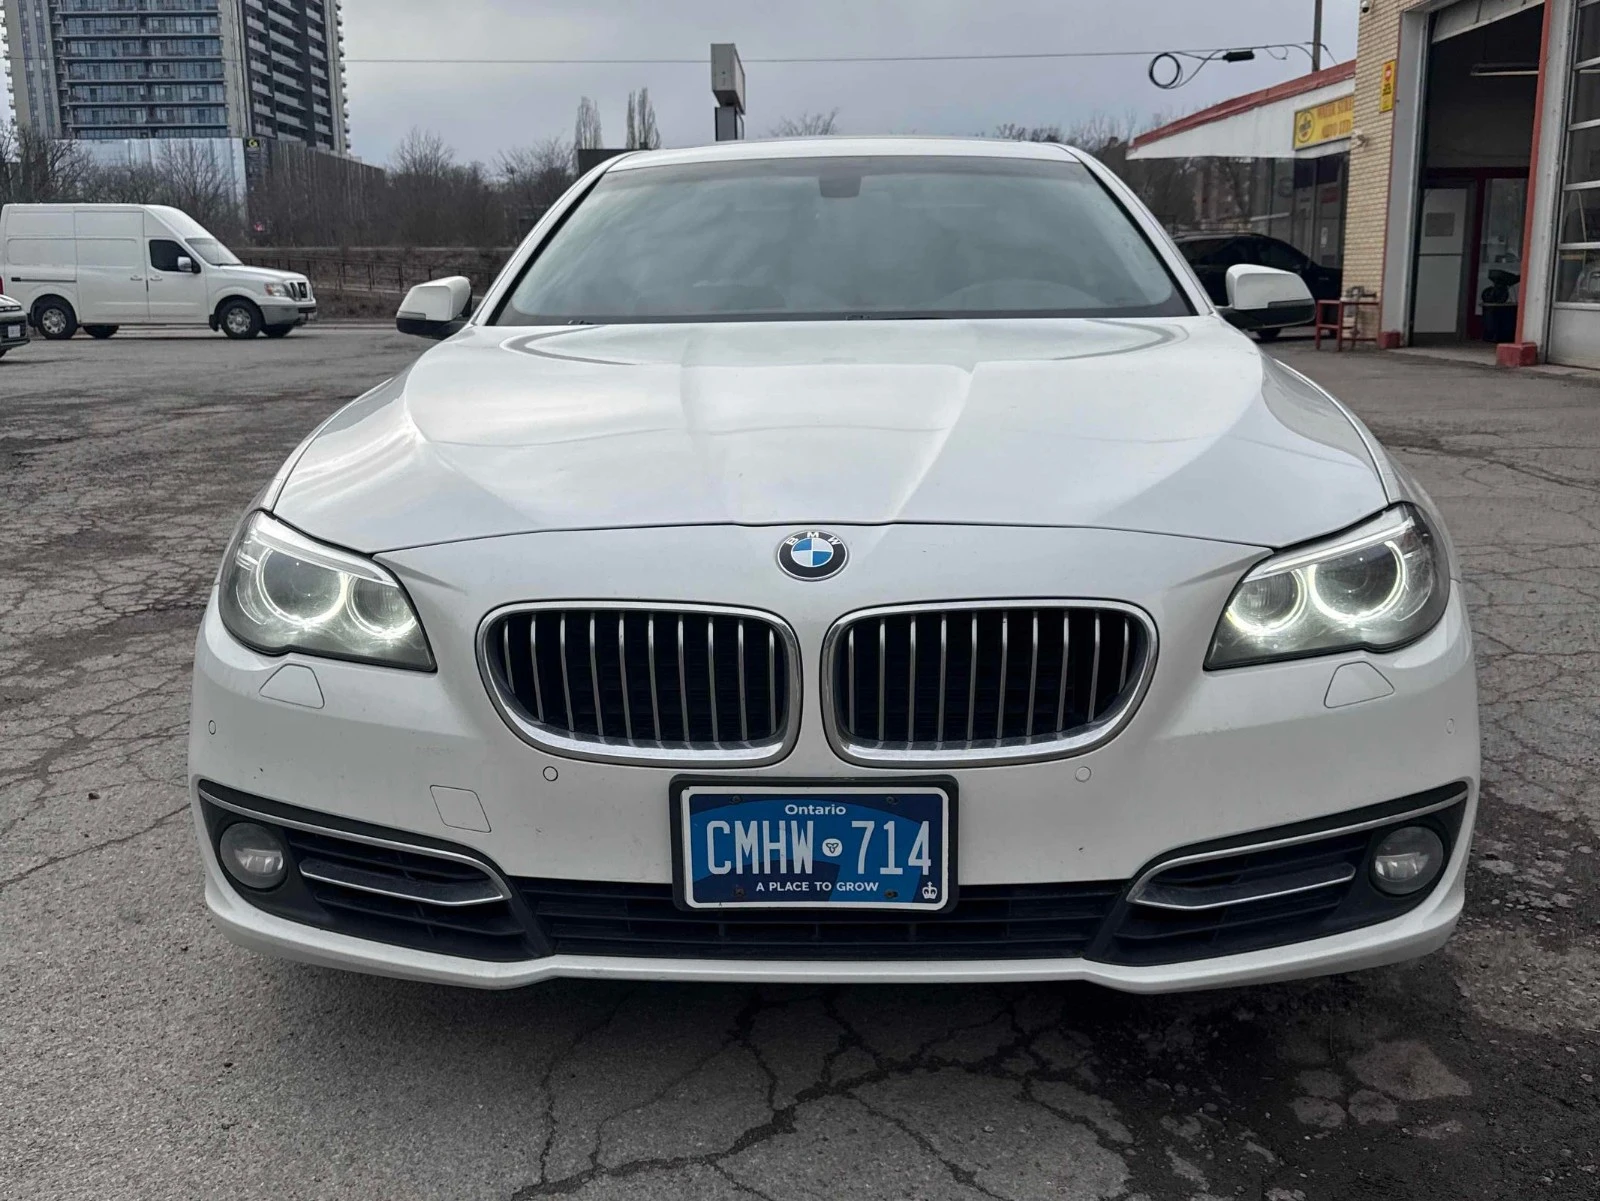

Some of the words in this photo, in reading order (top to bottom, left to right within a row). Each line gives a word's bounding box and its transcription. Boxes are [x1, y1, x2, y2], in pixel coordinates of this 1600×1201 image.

[786, 531, 841, 546] BMW
[785, 804, 847, 815] Ontario
[706, 820, 814, 875] CMHW
[851, 820, 932, 876] 714
[756, 882, 765, 892] A
[769, 882, 810, 892] PLACE
[814, 882, 832, 892] TO
[836, 882, 879, 892] GROW
